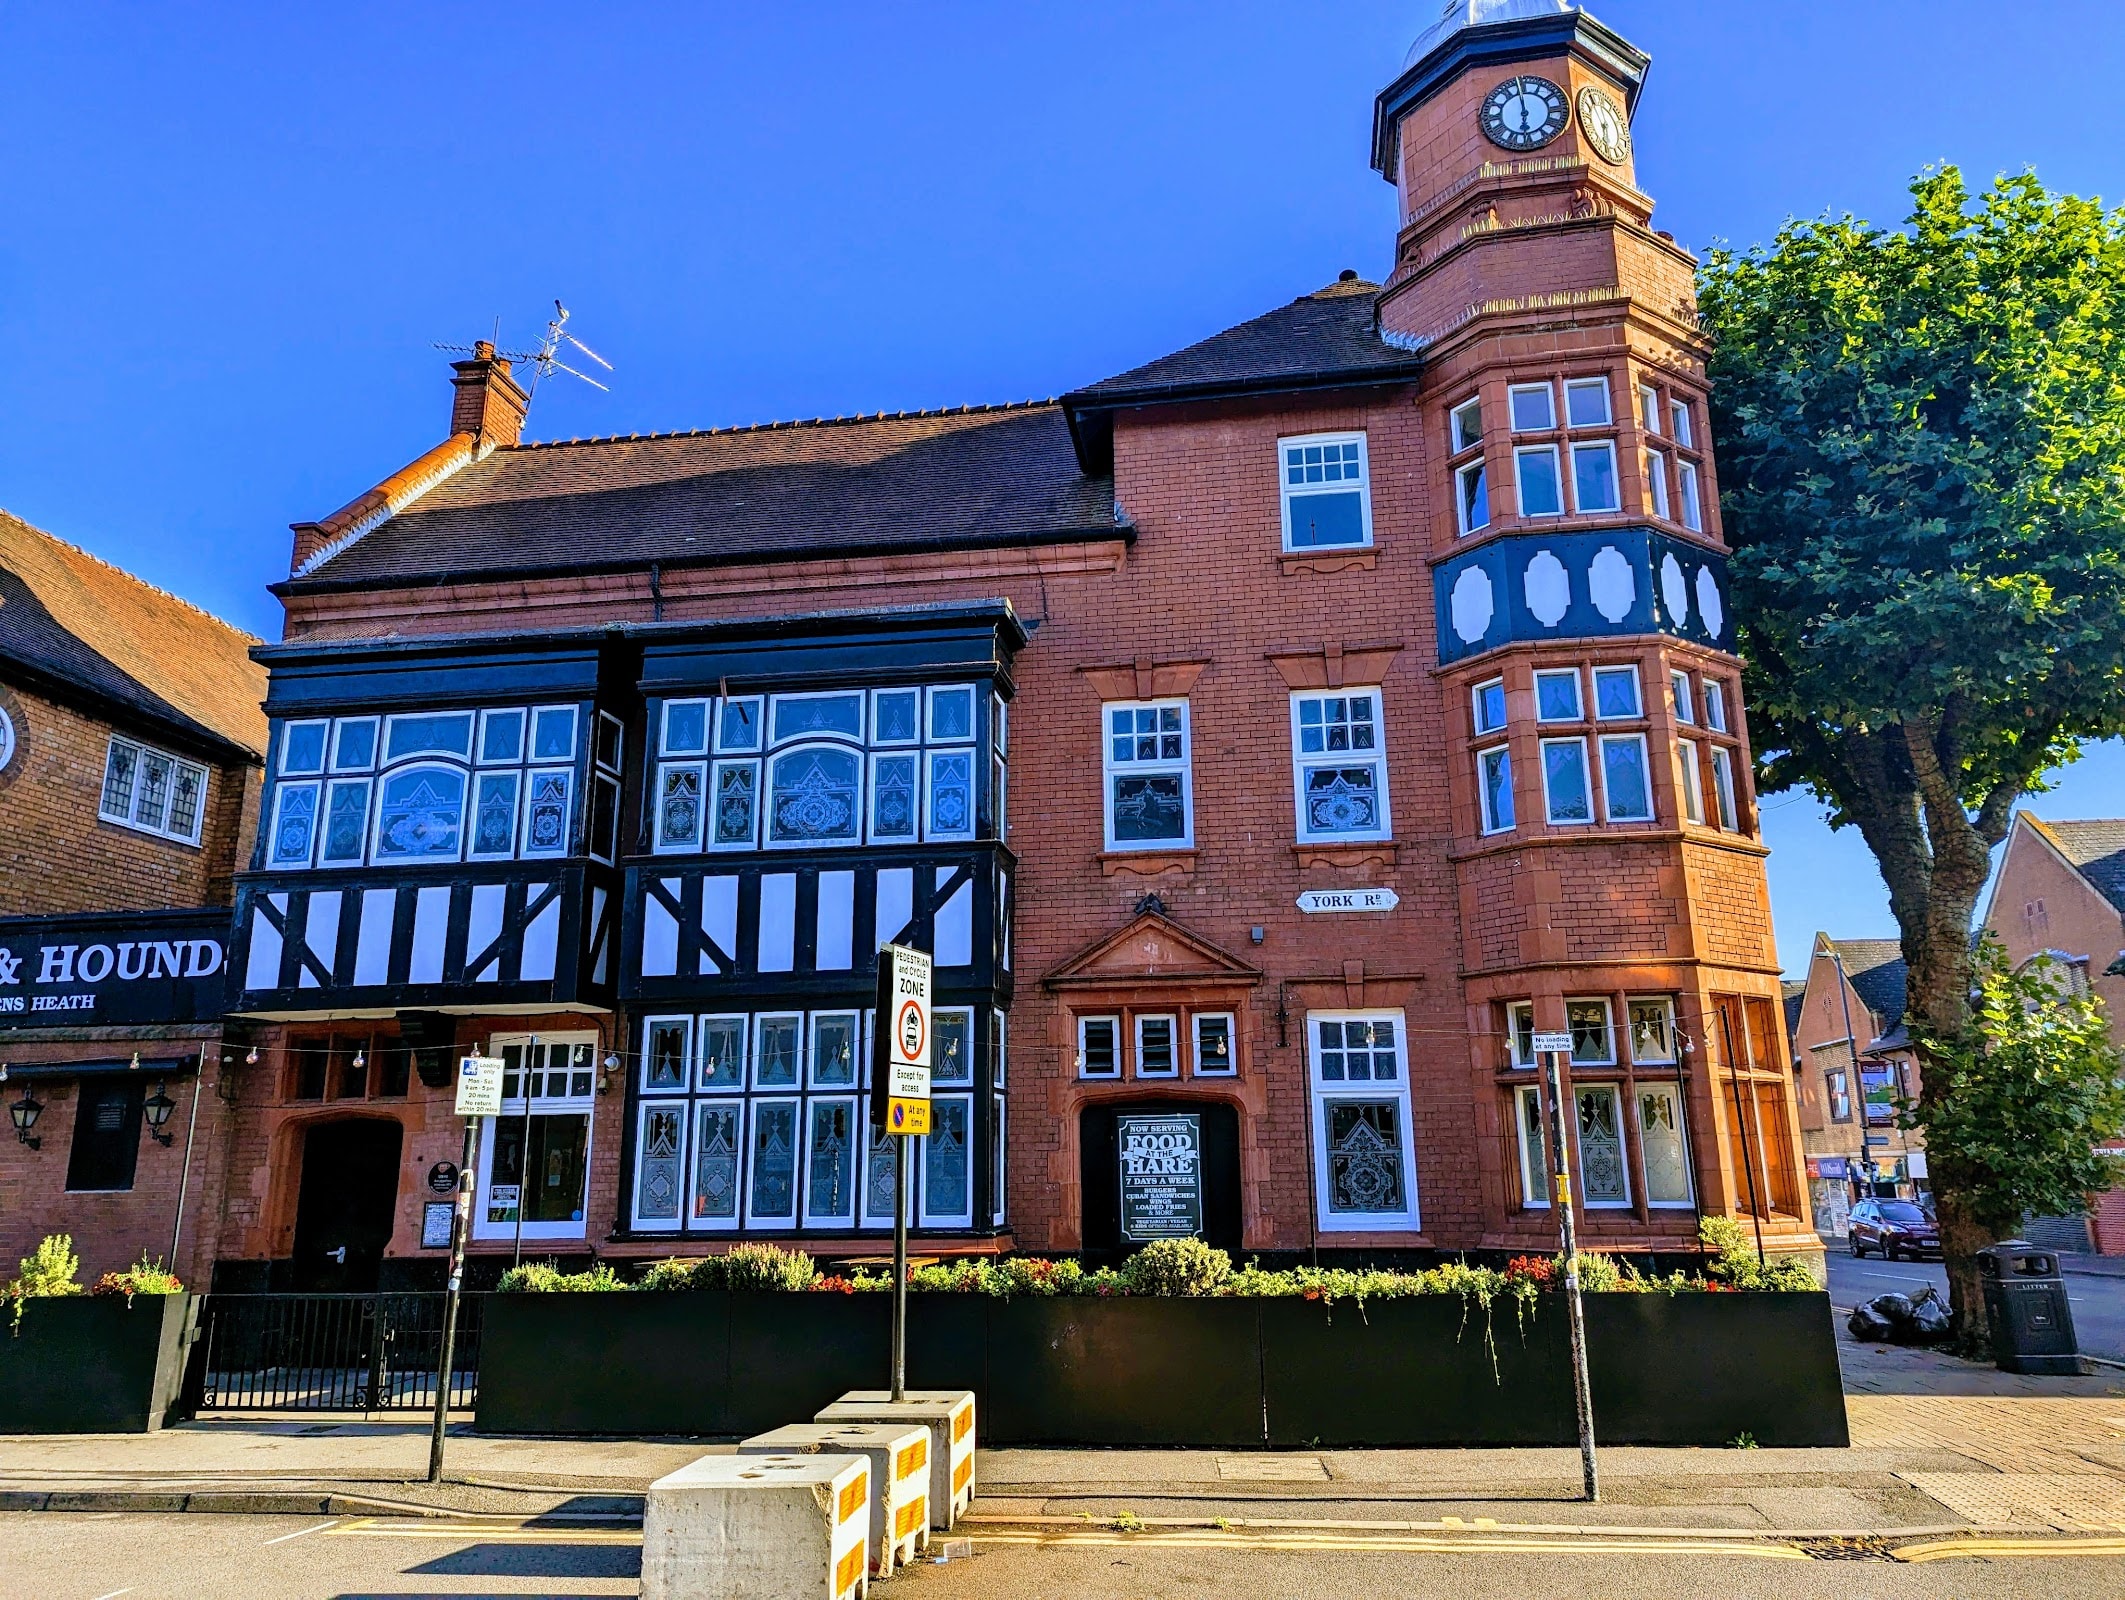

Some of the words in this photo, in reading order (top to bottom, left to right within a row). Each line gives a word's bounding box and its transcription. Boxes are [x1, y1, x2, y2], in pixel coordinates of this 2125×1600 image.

[1311, 895, 1353, 908] YORK
[0, 947, 23, 985] &
[36, 939, 229, 983] HOUND
[895, 950, 930, 969] PEDESTRIAN
[898, 965, 909, 975] and
[909, 966, 926, 979] CYCLE
[900, 977, 925, 998] ZONE
[0, 996, 25, 1012] NS
[31, 994, 96, 1011] HEATH
[896, 1068, 916, 1081] Except
[916, 1071, 925, 1081] for
[901, 1083, 920, 1093] access
[908, 1104, 915, 1115] At
[915, 1106, 926, 1117] any
[910, 1117, 923, 1127] time
[1129, 1125, 1149, 1133] NOW
[1150, 1124, 1188, 1132] SERVING
[1127, 1134, 1191, 1151] FOOD
[1156, 1149, 1174, 1158] THE
[1127, 1158, 1193, 1174] HARE
[1125, 1177, 1132, 1185] 7
[1134, 1177, 1158, 1185] DAYS
[1159, 1177, 1167, 1185] A
[1167, 1176, 1196, 1184] WEEK
